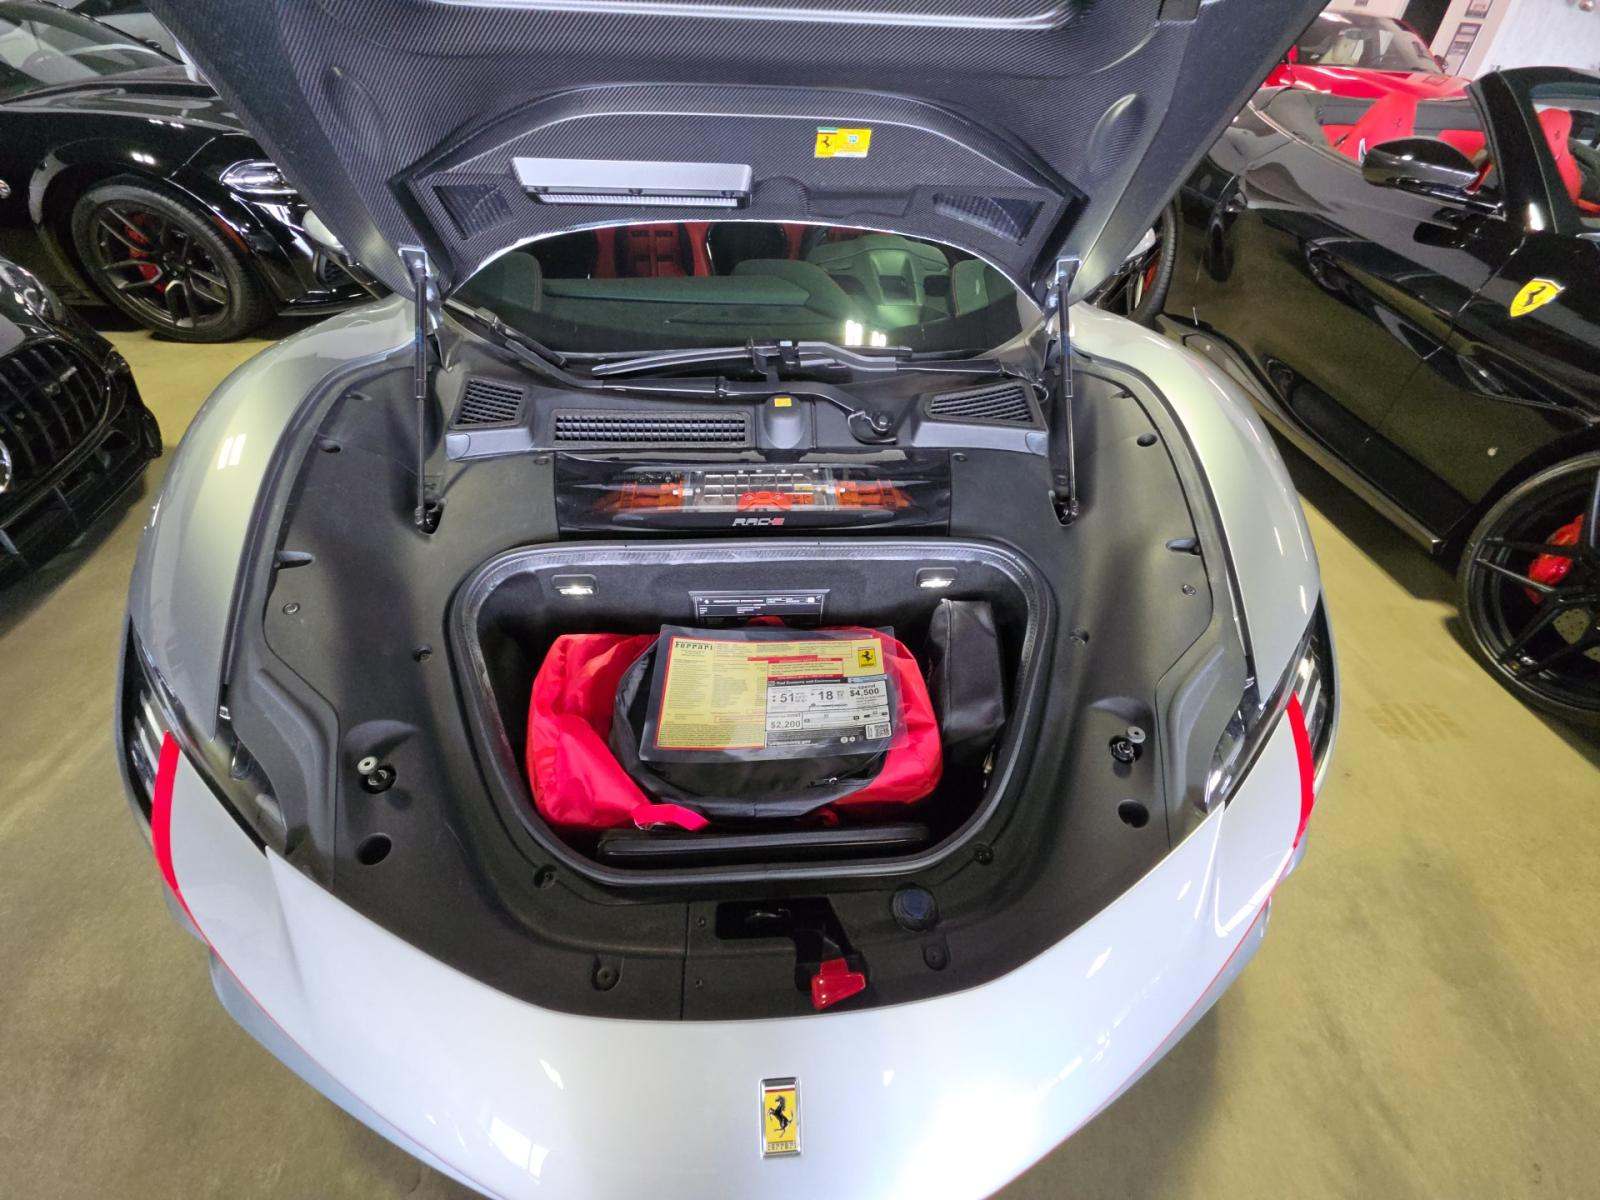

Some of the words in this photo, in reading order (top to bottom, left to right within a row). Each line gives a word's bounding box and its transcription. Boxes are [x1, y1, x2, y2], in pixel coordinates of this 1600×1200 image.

[675, 641, 713, 650] Ferrari
[818, 691, 834, 700] 18
[849, 688, 880, 697] $4,500
[780, 693, 794, 703] 51
[770, 719, 801, 729] $2,200
